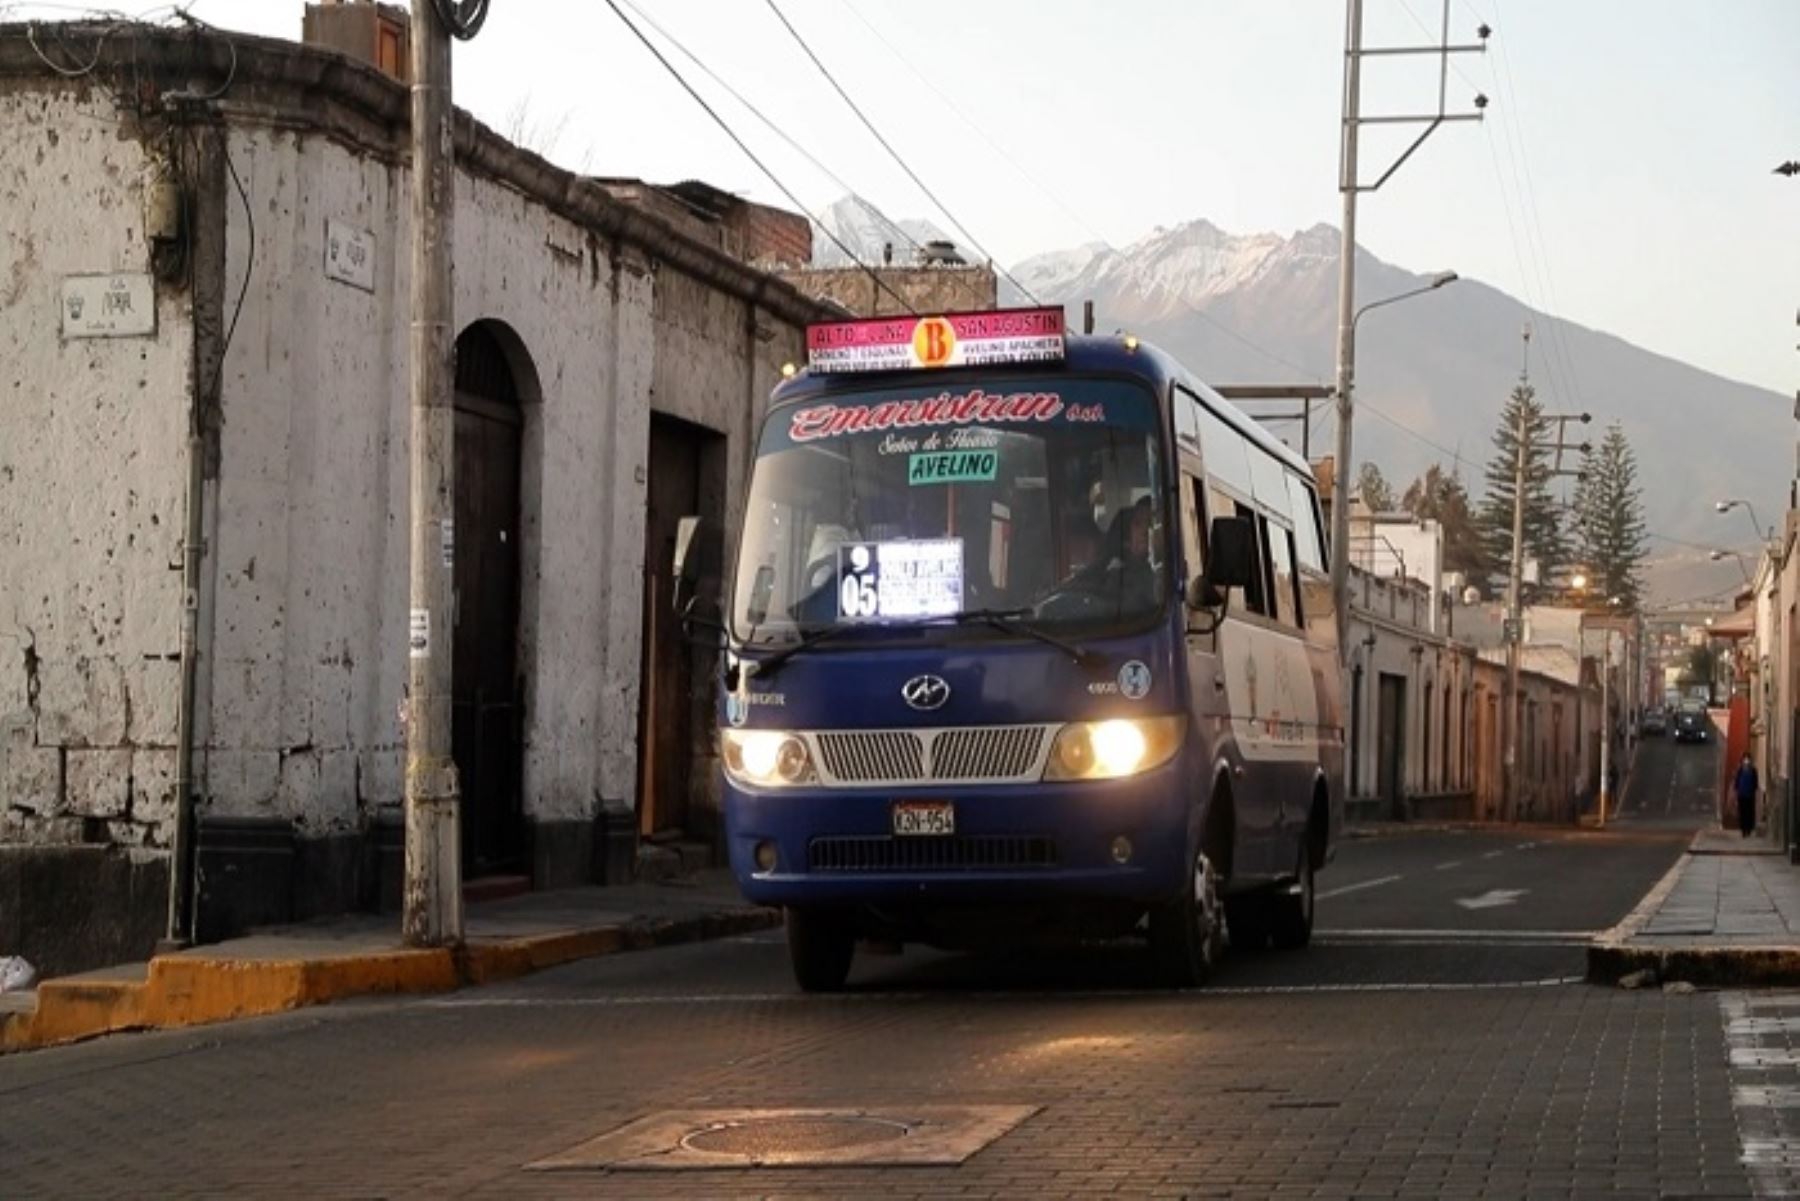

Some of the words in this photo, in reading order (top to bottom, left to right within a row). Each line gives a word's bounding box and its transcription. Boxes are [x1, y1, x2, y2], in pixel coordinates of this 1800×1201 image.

[816, 327, 854, 343] ALTO
[958, 319, 988, 335] SAN
[992, 313, 1058, 334] AGUSTIN
[923, 322, 947, 361] B
[963, 341, 1006, 355] AVELINO
[788, 388, 1065, 442] Emarsistran
[921, 431, 941, 450] de
[912, 453, 994, 478] AVELINO
[841, 573, 877, 617] 05
